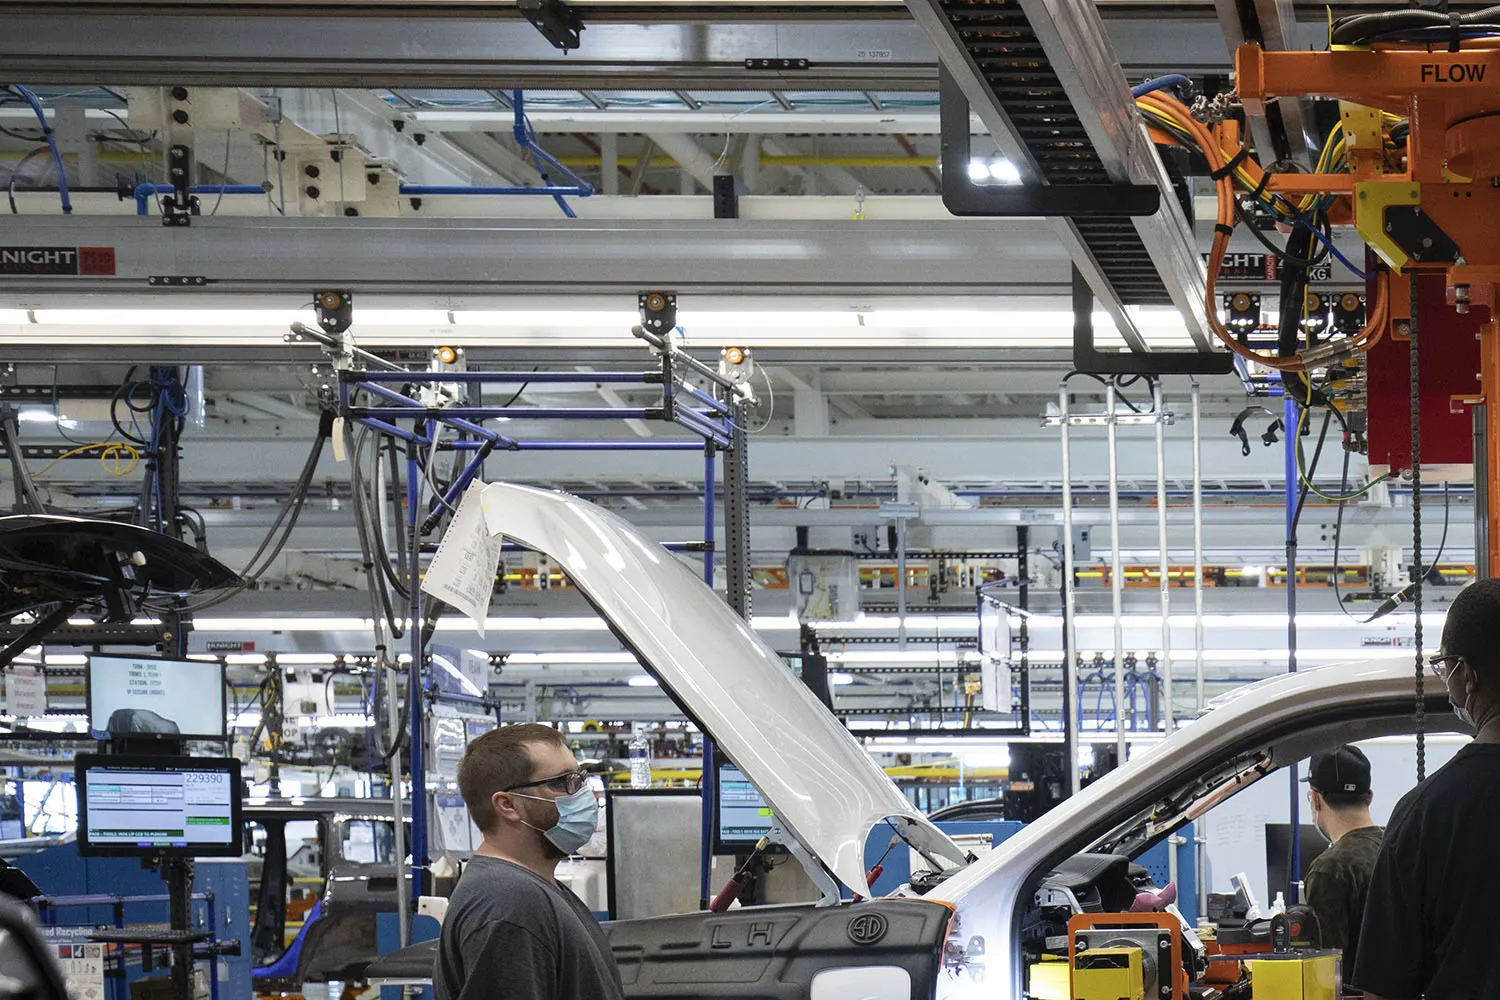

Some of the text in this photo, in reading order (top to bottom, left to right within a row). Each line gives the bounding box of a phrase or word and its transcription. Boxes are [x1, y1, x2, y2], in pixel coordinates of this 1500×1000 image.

[1420, 63, 1487, 83] FLOW
[0, 250, 75, 264] NIGHT
[185, 773, 223, 784] 229390
